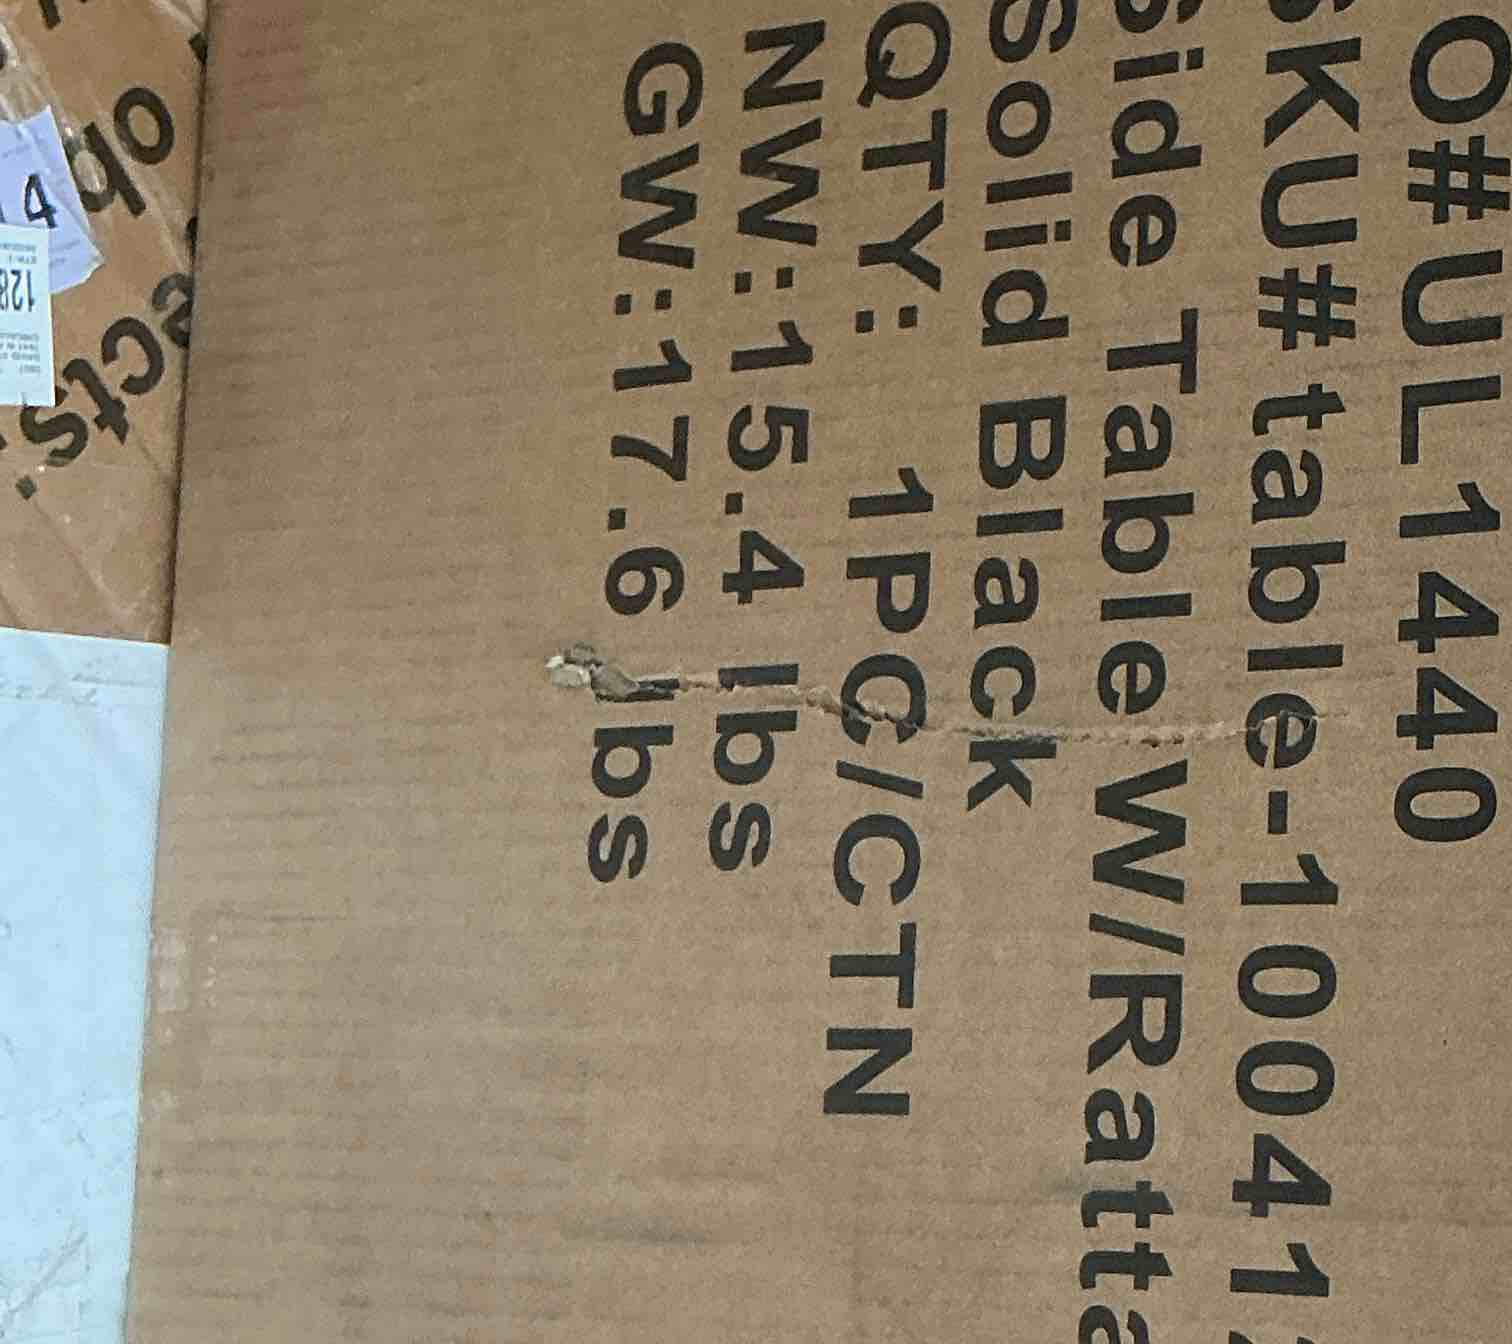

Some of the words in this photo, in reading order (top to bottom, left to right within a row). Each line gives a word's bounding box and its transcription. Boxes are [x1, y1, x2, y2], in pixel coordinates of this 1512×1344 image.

[605, 42, 703, 615] GW:17.6
[723, 20, 826, 605] NW:15.4
[856, 1, 951, 333] QTY:
[967, 395, 1066, 811] Black
[1097, 308, 1198, 715] Table
[588, 679, 680, 883] lbs
[709, 664, 798, 871] lbs
[822, 468, 933, 1115] 1PC/CTN
